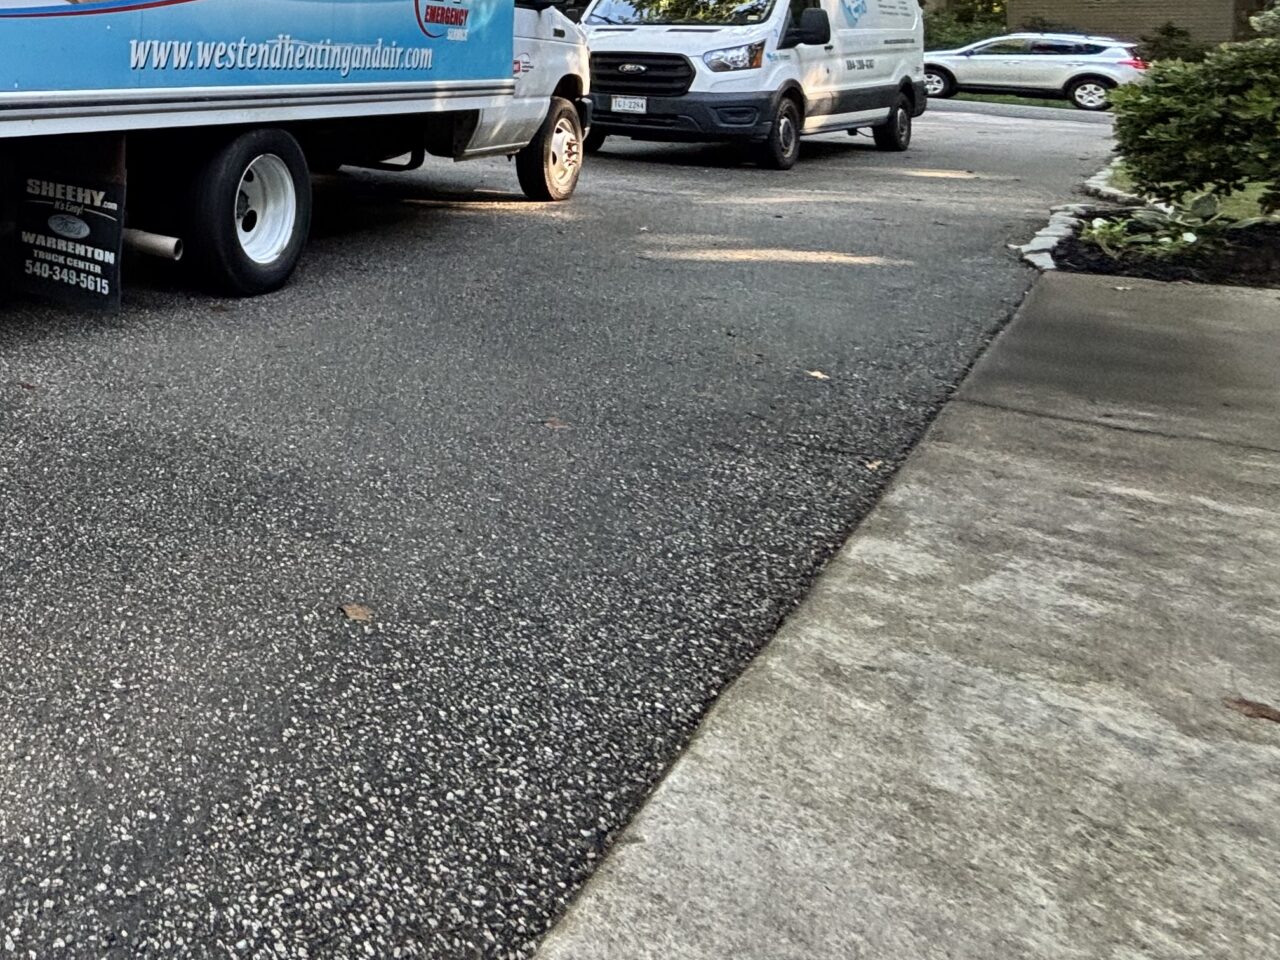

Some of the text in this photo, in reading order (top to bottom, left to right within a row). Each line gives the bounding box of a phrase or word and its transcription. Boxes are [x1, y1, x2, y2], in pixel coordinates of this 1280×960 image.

[424, 5, 469, 26] EMERGENCY
[130, 34, 433, 78] www.westendheatingandair.com
[21, 231, 115, 264] WARRENTON
[33, 249, 102, 274] TRUCK CENTER
[25, 260, 109, 295] 540-349-5615
